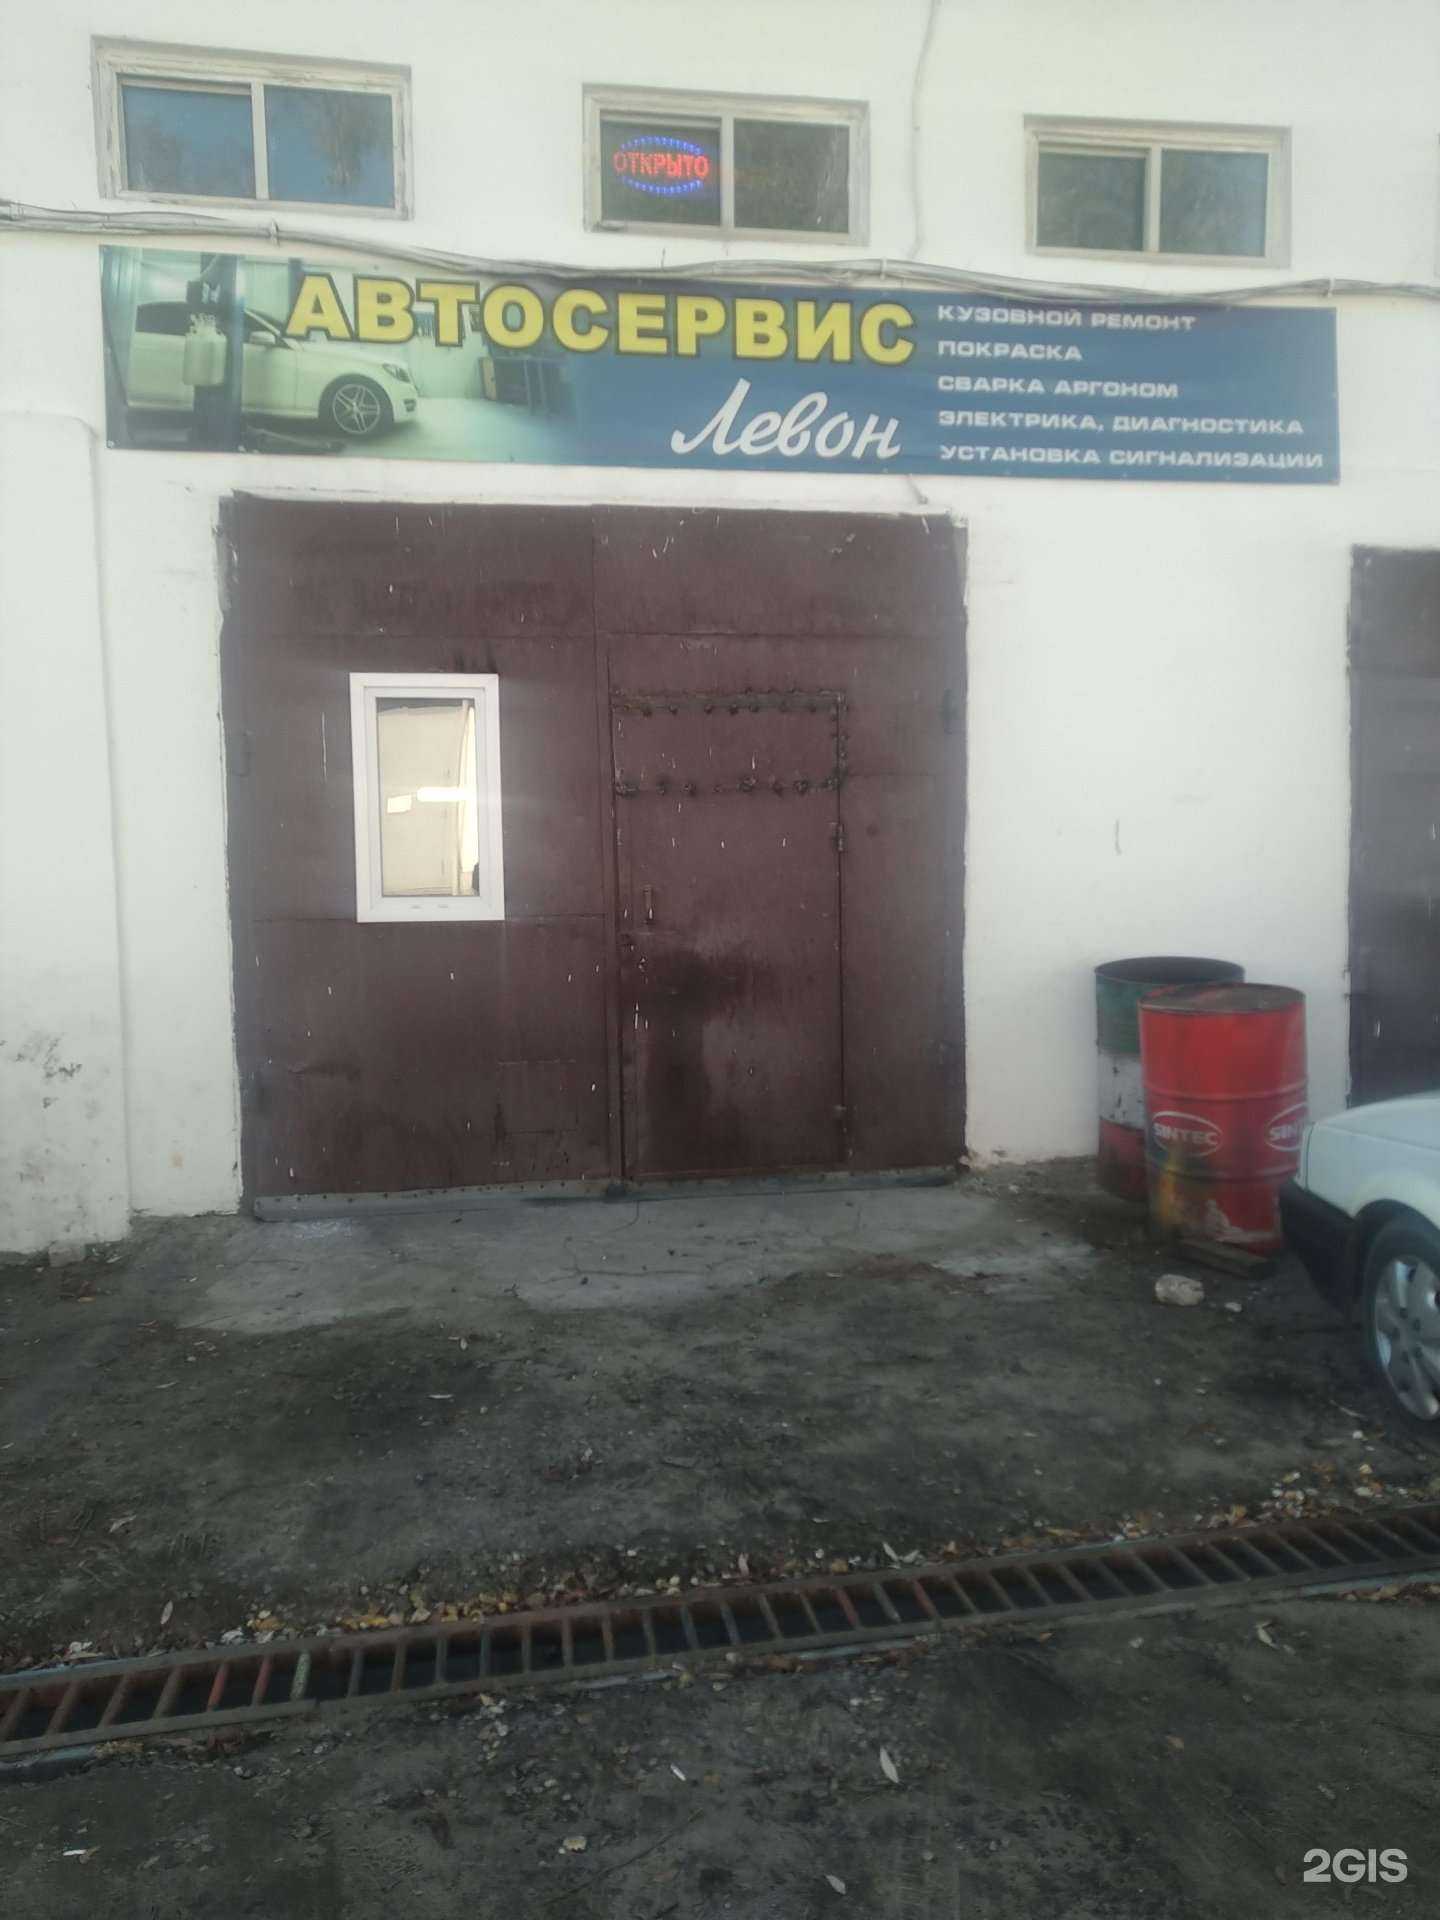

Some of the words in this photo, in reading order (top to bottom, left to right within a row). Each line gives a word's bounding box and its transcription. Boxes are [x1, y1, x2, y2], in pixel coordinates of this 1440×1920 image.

[613, 151, 711, 178] ОТКРЫТО
[285, 273, 916, 366] АВТОСЕРВИС
[937, 304, 1082, 328] КУЗОВНОЙ
[1090, 312, 1196, 331] РЕМОНТ
[937, 340, 1083, 361] ПОКРАСКА
[937, 375, 1045, 395] СВАРКА
[1053, 381, 1179, 399] АРГОНОМ
[670, 377, 901, 461] Левон
[938, 410, 1104, 432] ЭЛЕКТРИКА,
[1112, 416, 1305, 436] ДИАГНОСТИКА
[940, 444, 1100, 465] УСТАНОВКА
[1109, 448, 1323, 470] СИГНАЛИЗАЦИИ
